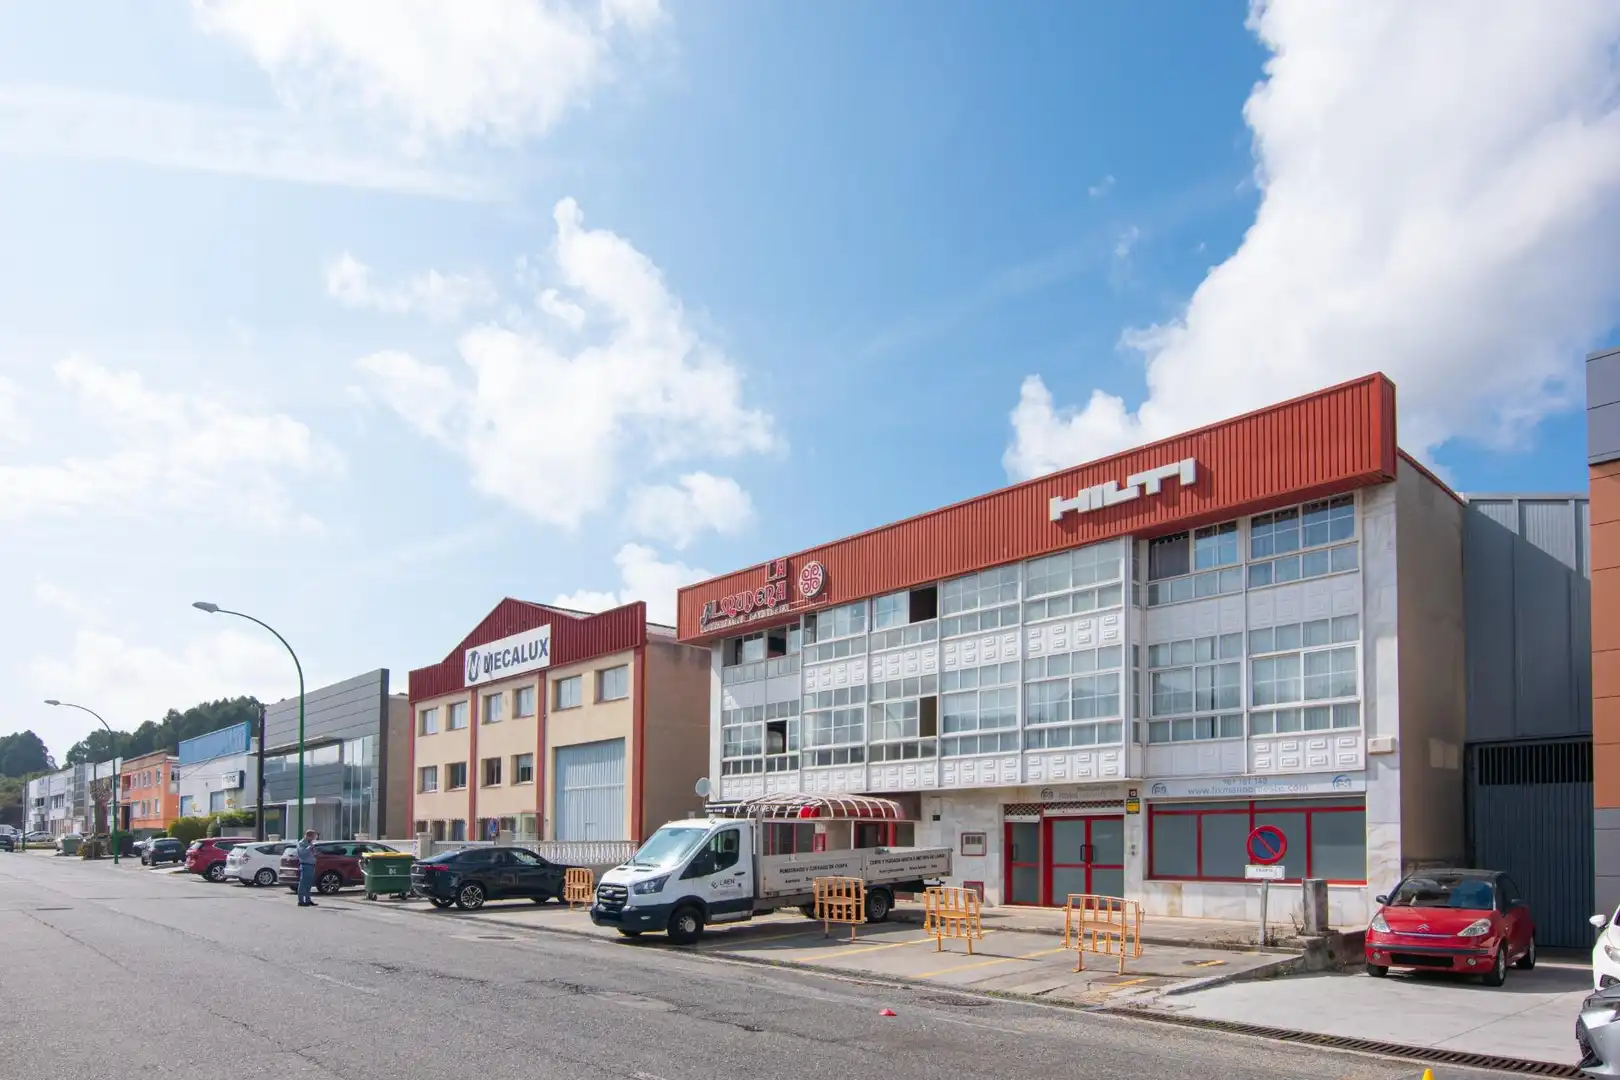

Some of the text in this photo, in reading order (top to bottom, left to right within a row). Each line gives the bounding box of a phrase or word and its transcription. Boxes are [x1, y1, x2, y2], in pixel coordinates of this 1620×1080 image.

[1050, 457, 1196, 521] HILTI
[765, 558, 787, 582] LA
[483, 637, 549, 674] MECALUX
